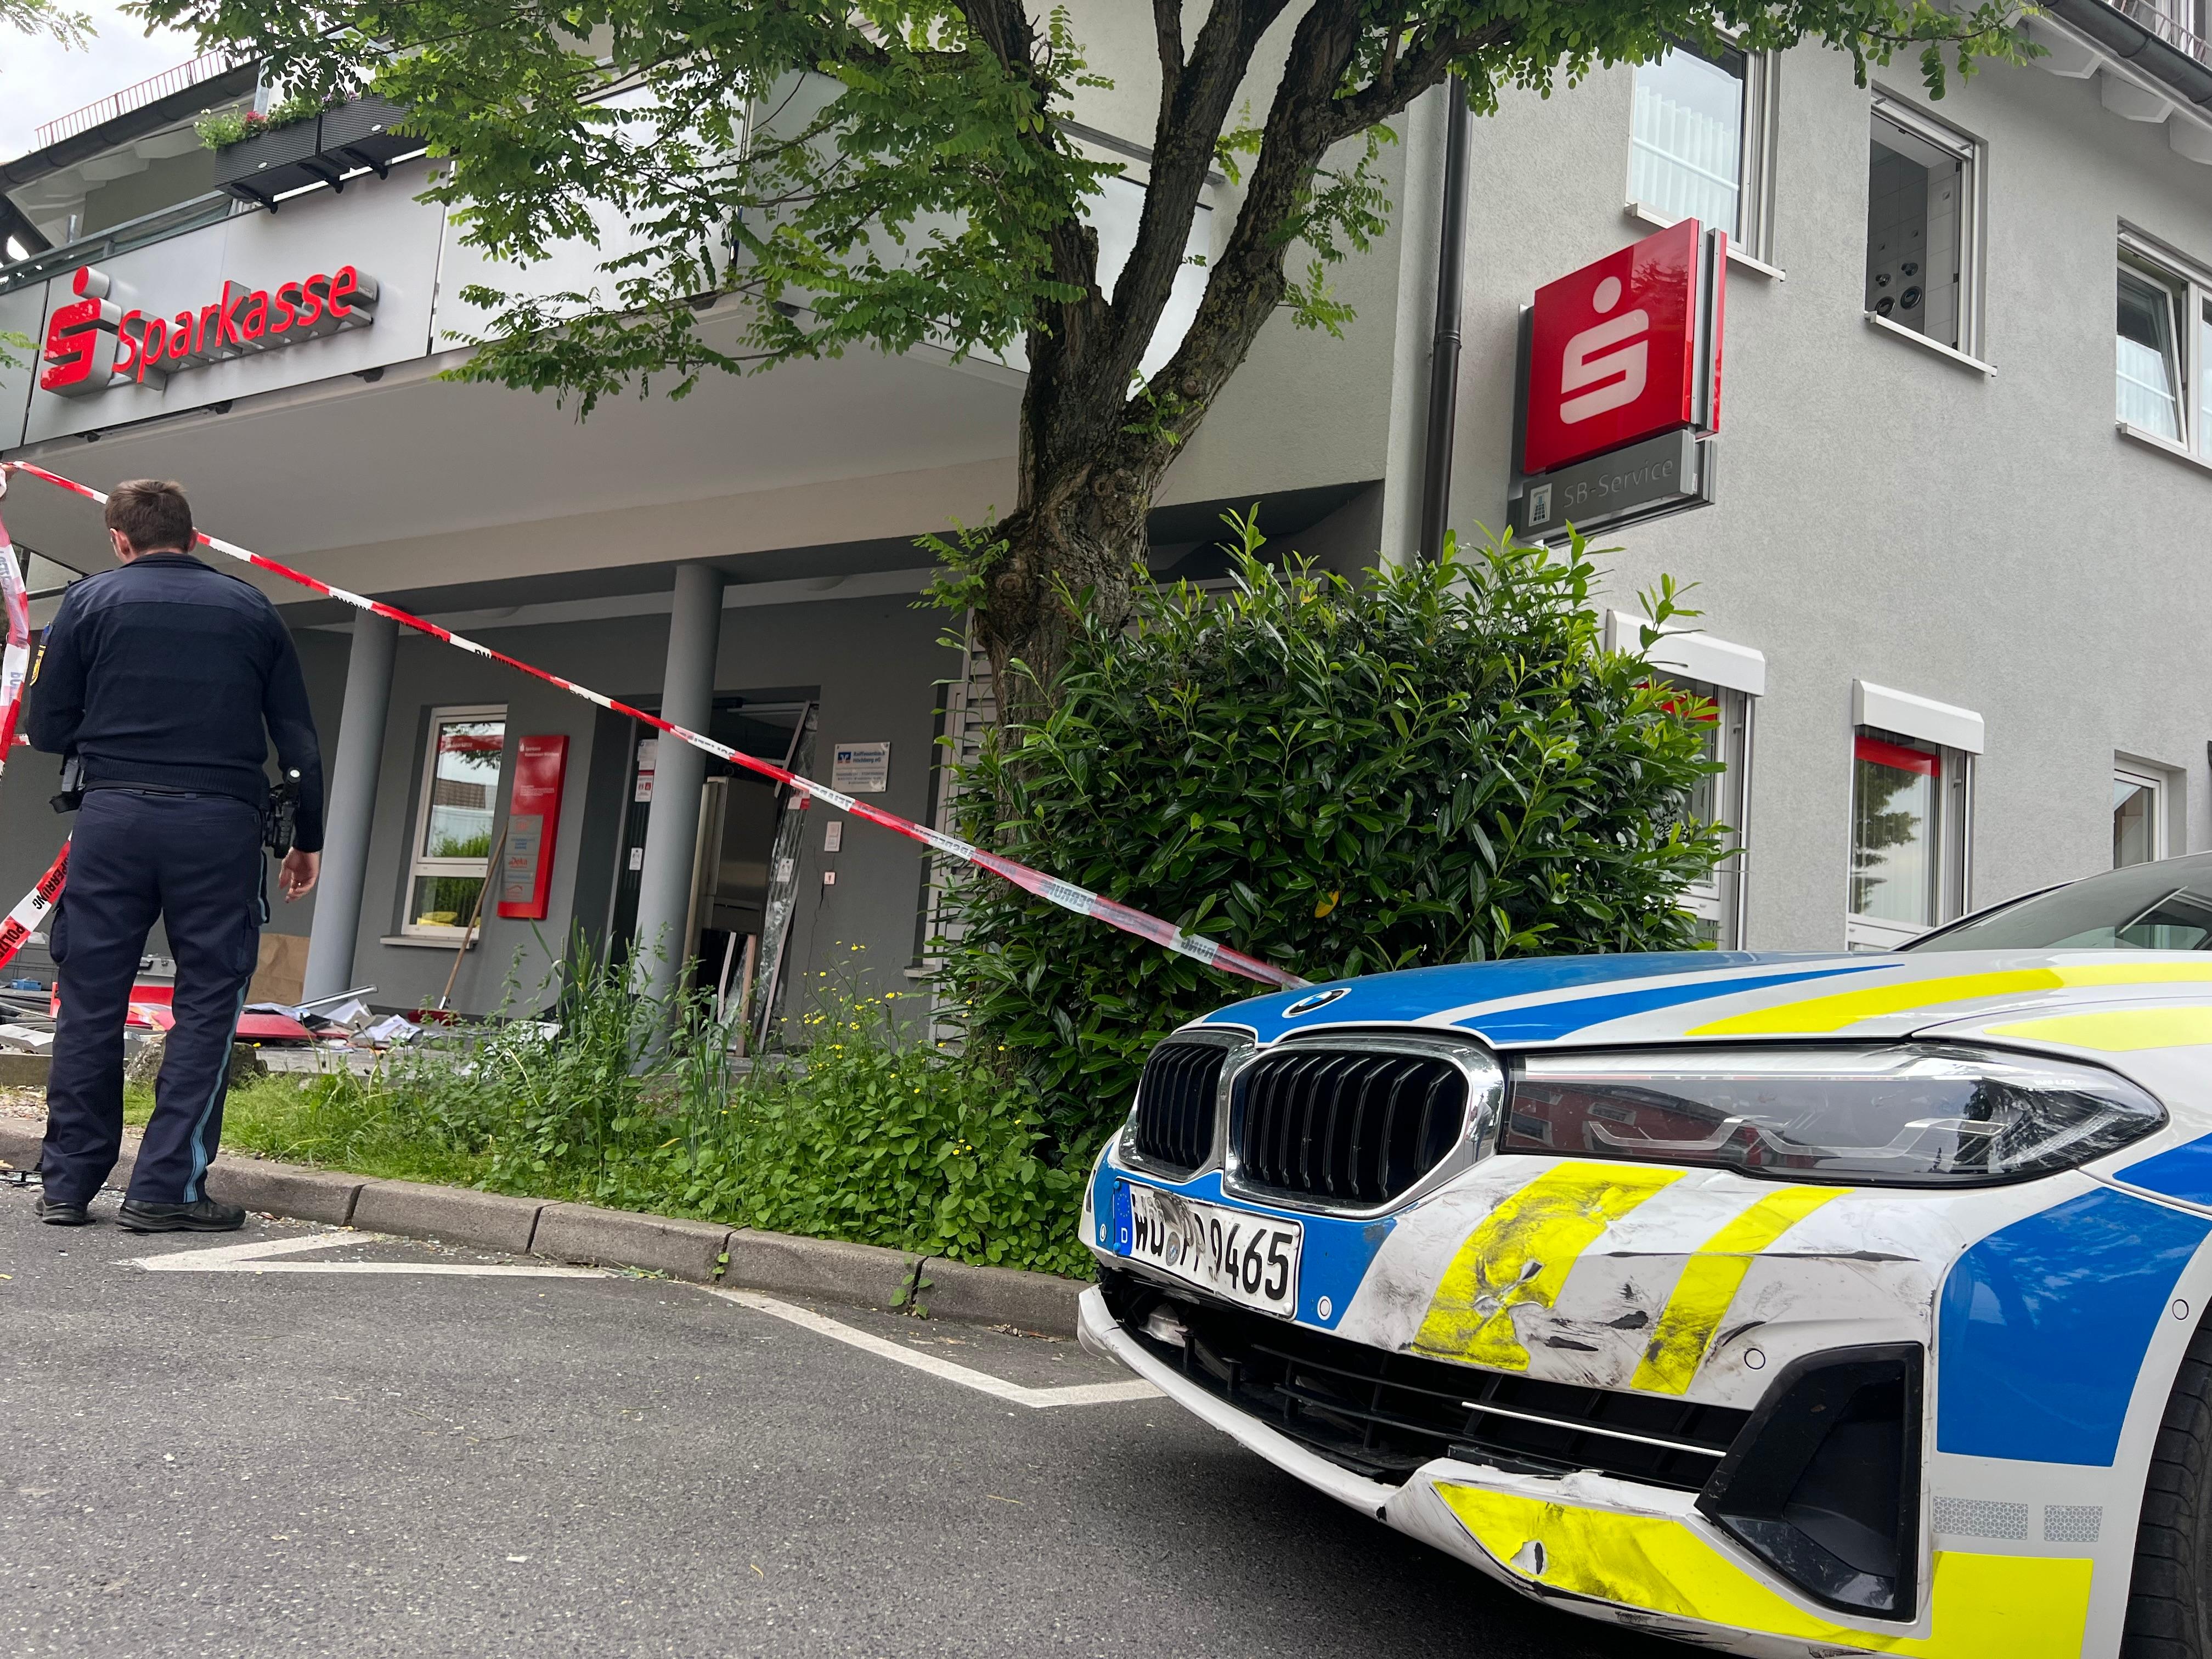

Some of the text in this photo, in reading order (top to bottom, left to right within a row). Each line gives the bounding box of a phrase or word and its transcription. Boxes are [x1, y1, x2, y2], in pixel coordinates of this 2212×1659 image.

[112, 265, 357, 383] Sparkasse
[1564, 459, 1673, 508] SB-Service
[1121, 1228, 1128, 1243] D
[1209, 1218, 1293, 1300] 9465
